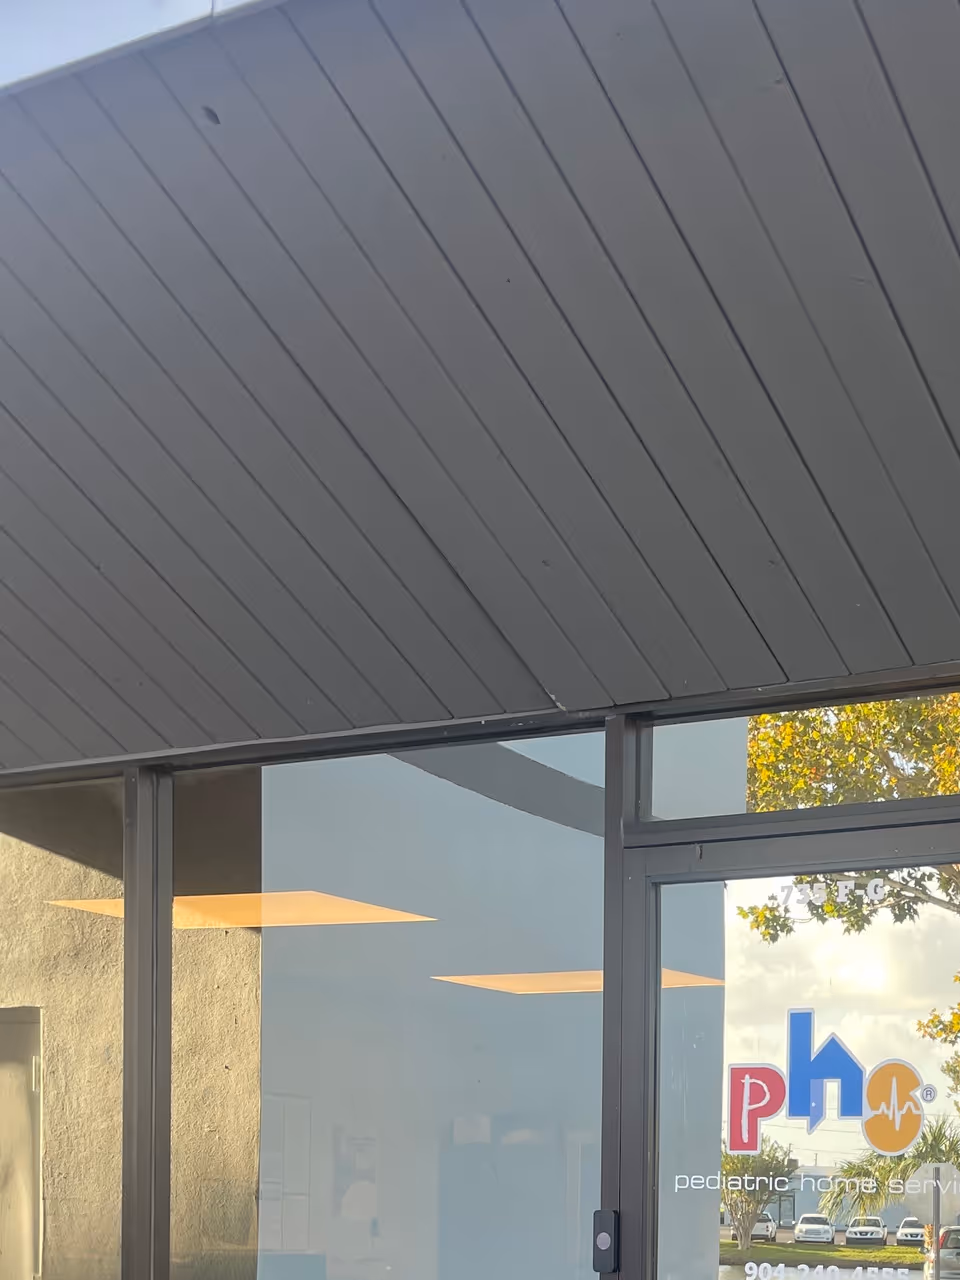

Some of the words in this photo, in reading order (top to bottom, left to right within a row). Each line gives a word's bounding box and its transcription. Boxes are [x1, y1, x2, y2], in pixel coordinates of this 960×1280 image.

[727, 1007, 925, 1156] phs
[674, 1171, 789, 1192] pediatric
[800, 1174, 877, 1193] home
